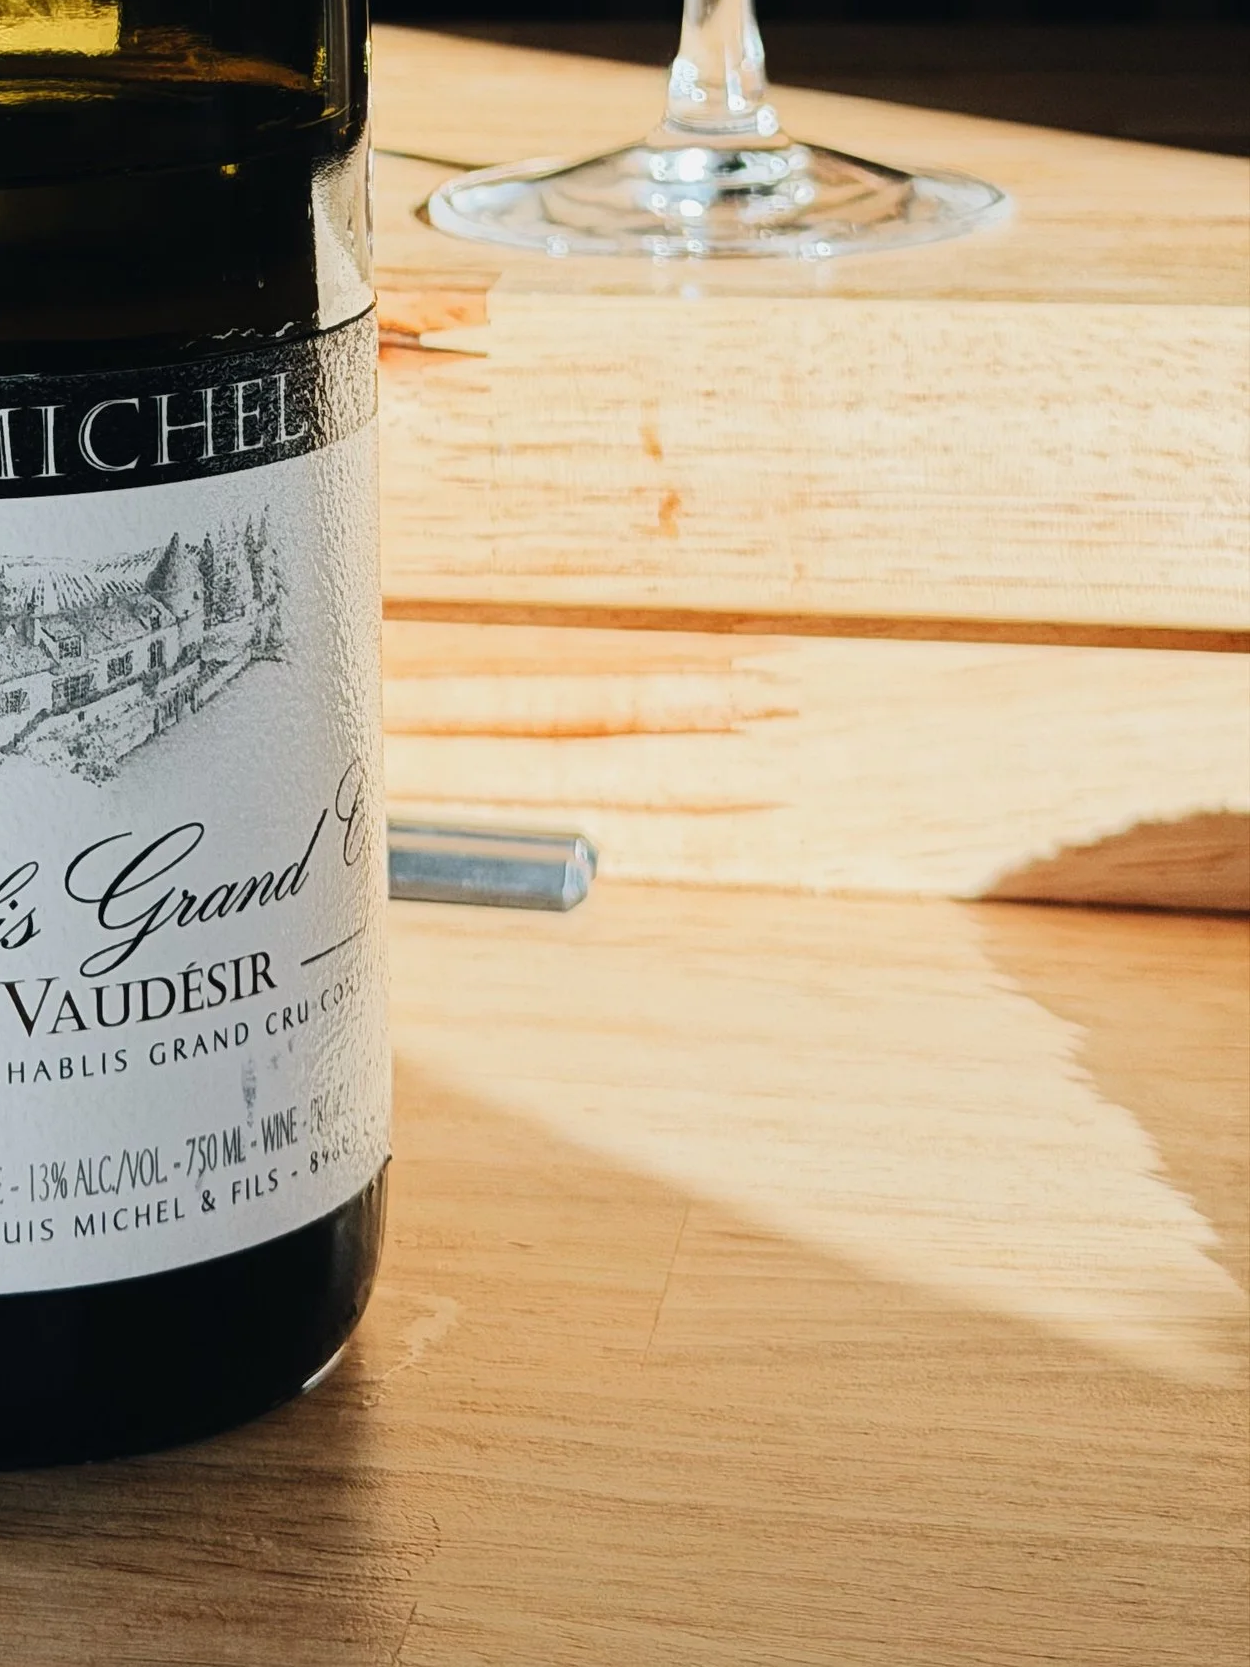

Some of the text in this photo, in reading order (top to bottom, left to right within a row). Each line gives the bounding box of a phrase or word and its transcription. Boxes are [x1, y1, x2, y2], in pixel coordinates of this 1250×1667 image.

[64, 806, 329, 979] Grand
[149, 1022, 249, 1066] GRAND
[265, 999, 310, 1035] CRU
[28, 1162, 69, 1203] 13%
[185, 1132, 218, 1178] 750
[222, 1124, 247, 1168] ML
[260, 1106, 298, 1155] WINE
[73, 1201, 186, 1238] MICHEL
[200, 1189, 216, 1213] &
[231, 1167, 280, 1206] FILS
